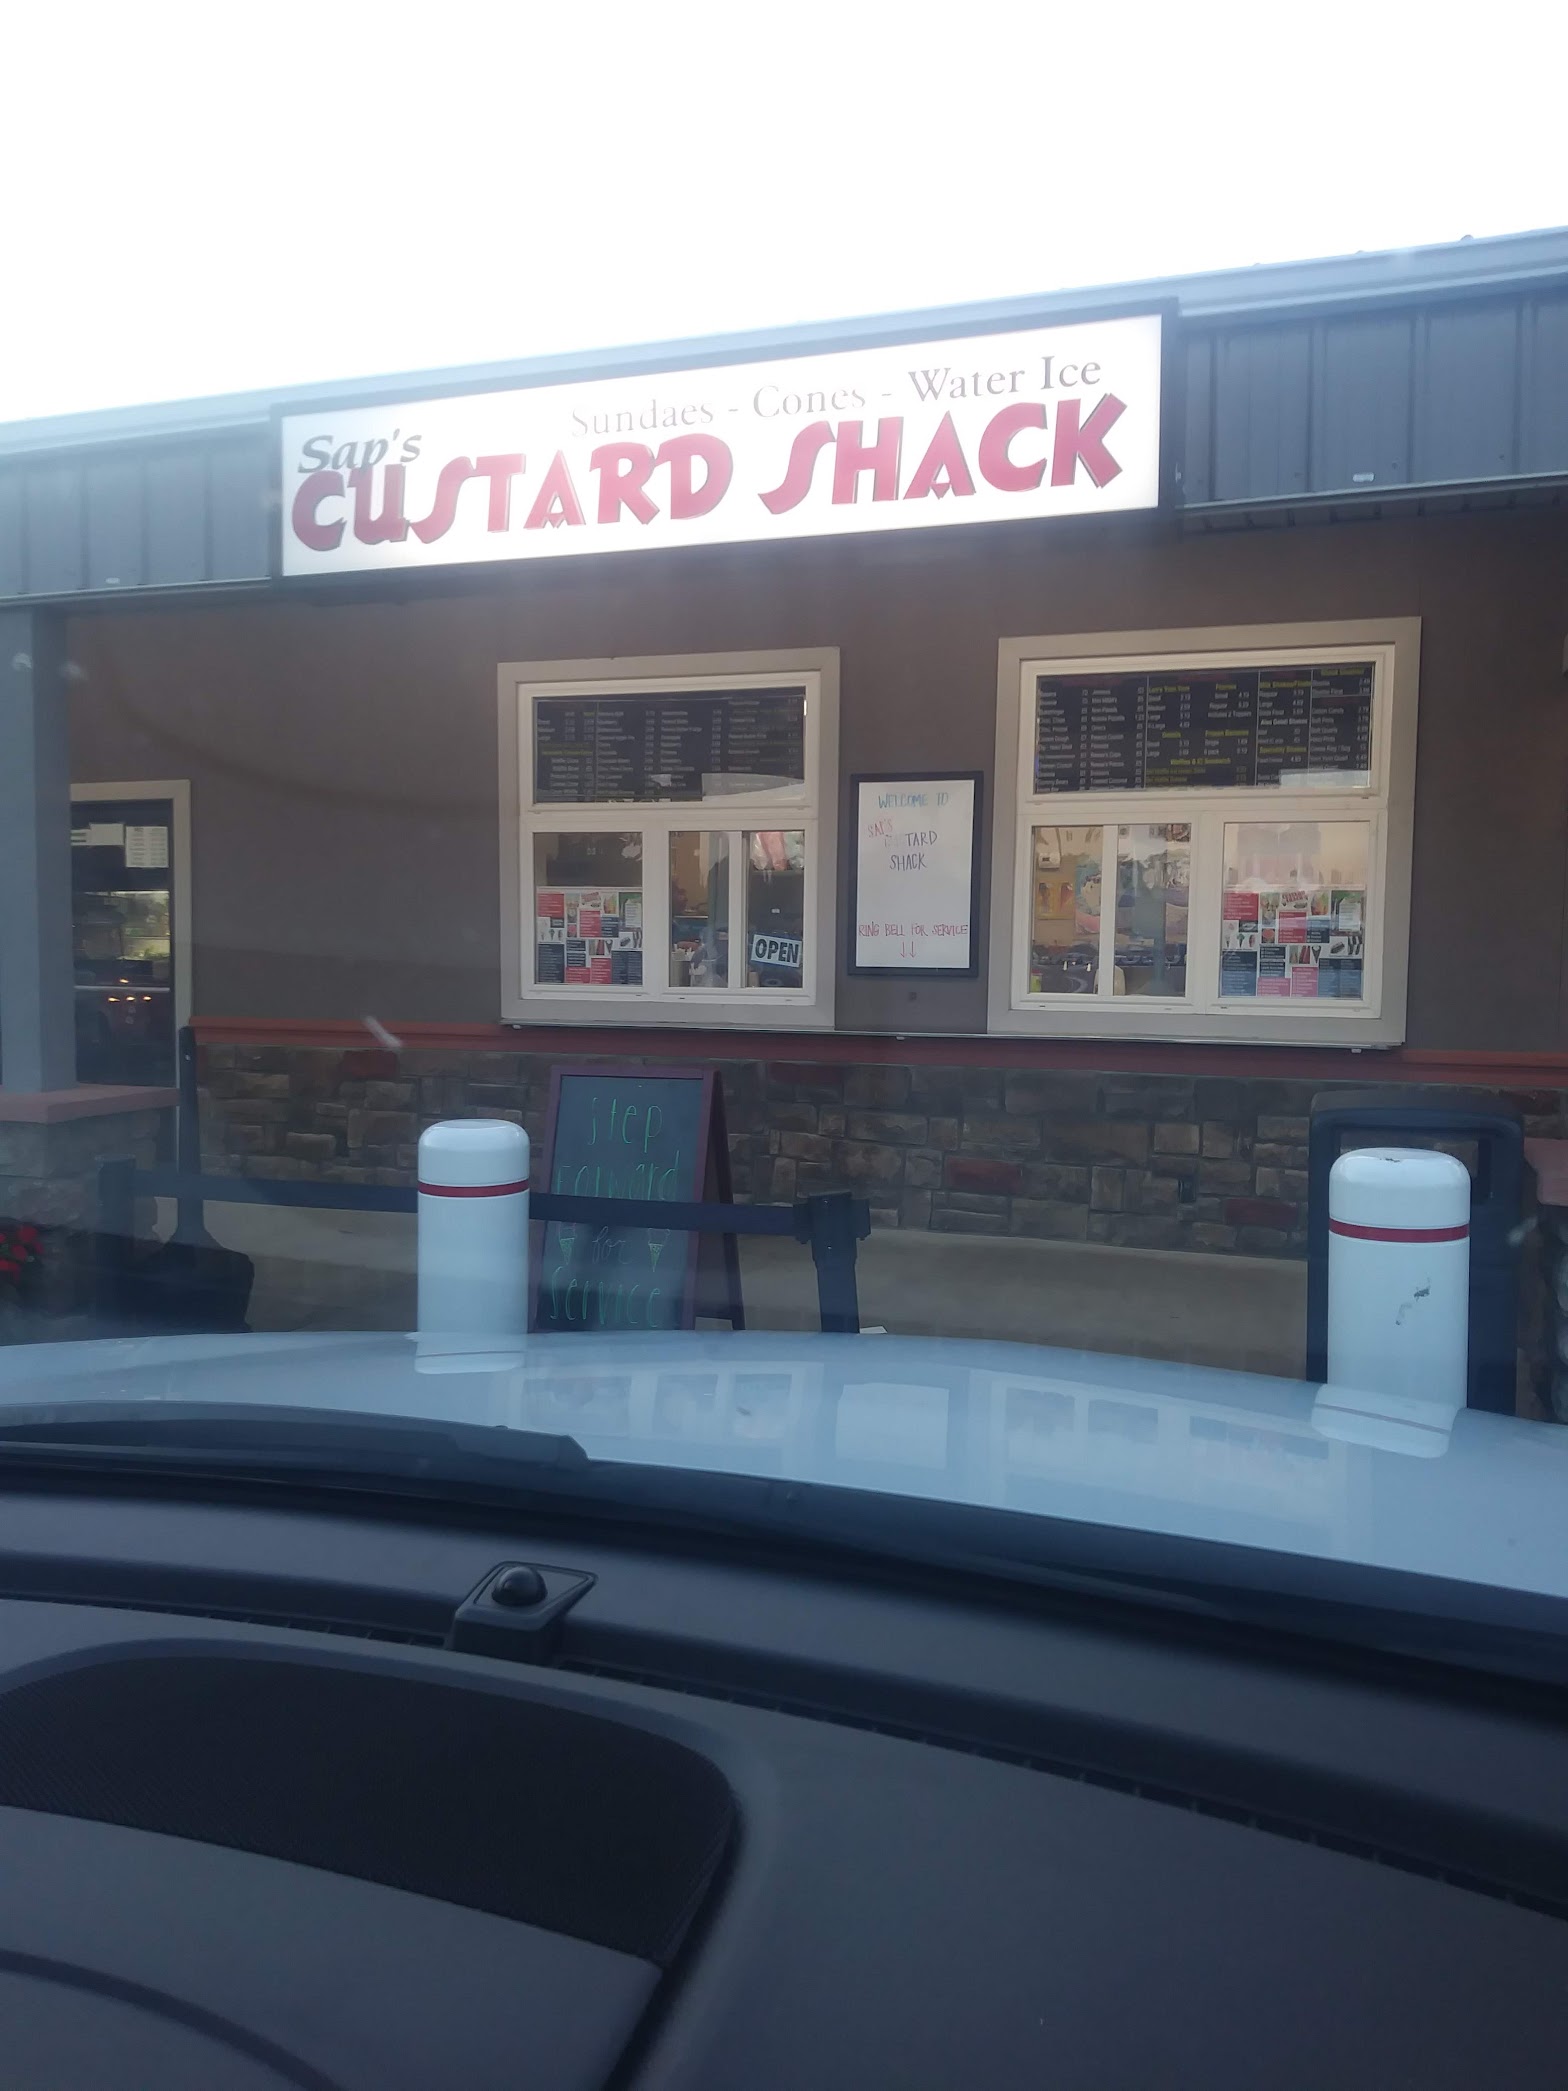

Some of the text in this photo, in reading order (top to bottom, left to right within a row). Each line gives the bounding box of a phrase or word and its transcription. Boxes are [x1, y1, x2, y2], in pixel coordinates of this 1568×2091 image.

[572, 400, 714, 438] Sundaes
[752, 385, 866, 418] Cones
[908, 367, 1026, 402] Water
[1040, 355, 1102, 390] Ice
[297, 428, 422, 474] Sap's
[292, 393, 1128, 552] CUSTARD SHACK
[878, 793, 929, 809] WELCOME
[889, 852, 927, 871] SHACK
[859, 921, 969, 937] RING BELL FOR SERVICE
[755, 938, 799, 964] OPEN
